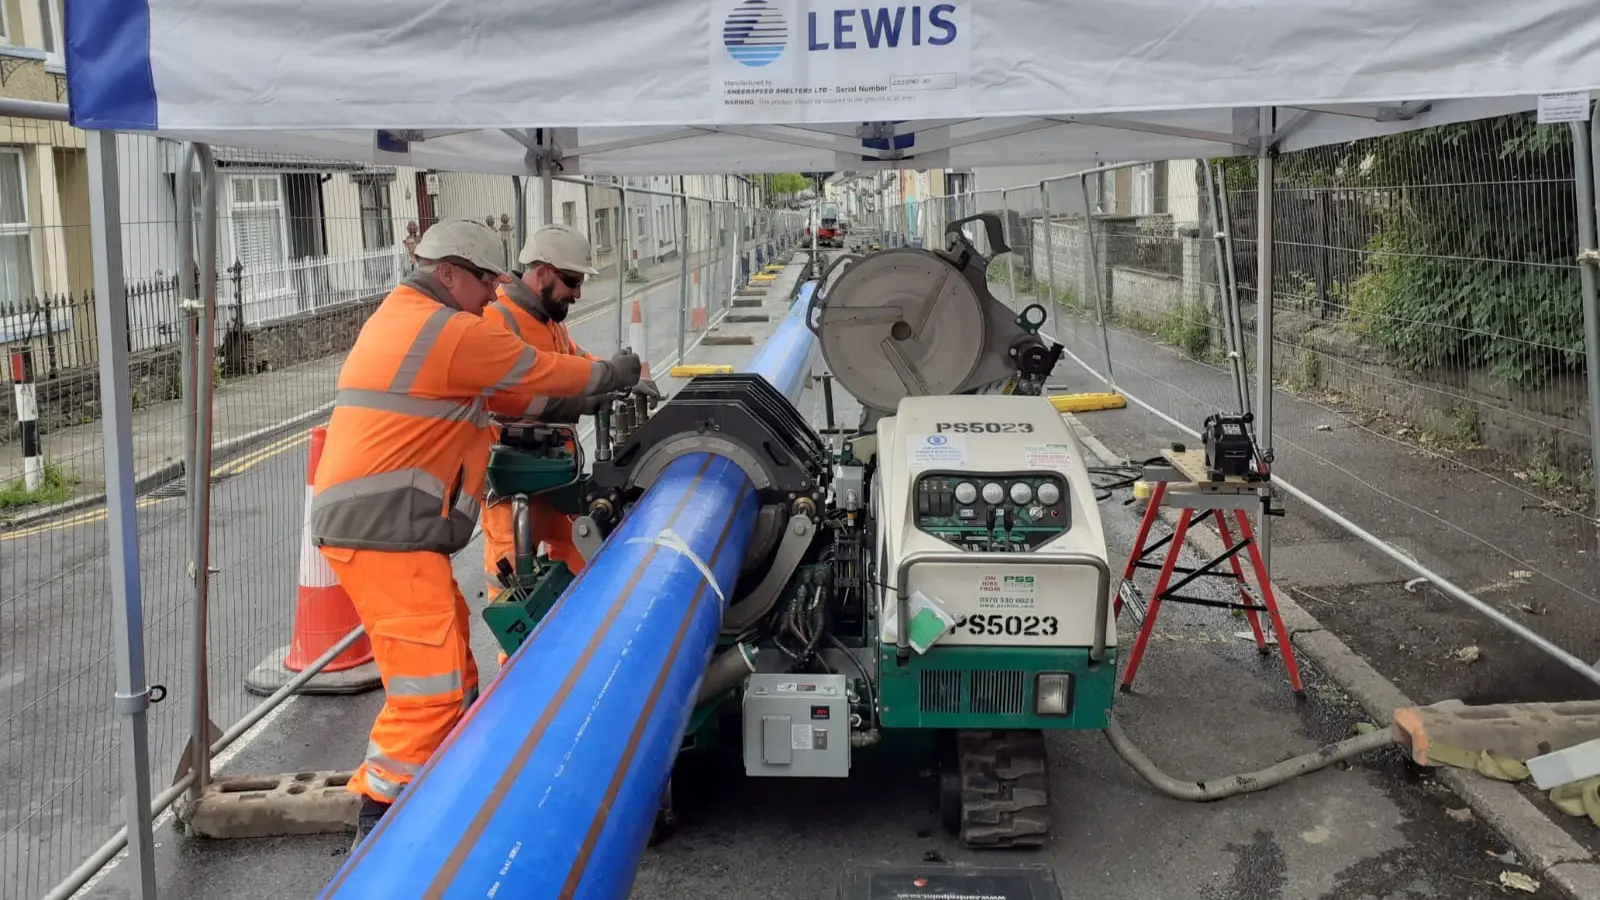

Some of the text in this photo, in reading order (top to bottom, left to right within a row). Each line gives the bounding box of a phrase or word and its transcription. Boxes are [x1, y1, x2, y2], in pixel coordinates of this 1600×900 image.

[808, 4, 957, 51] LEWIS
[859, 85, 888, 93] Number
[936, 422, 1034, 433] PS5023
[949, 614, 1058, 636] PS5023
